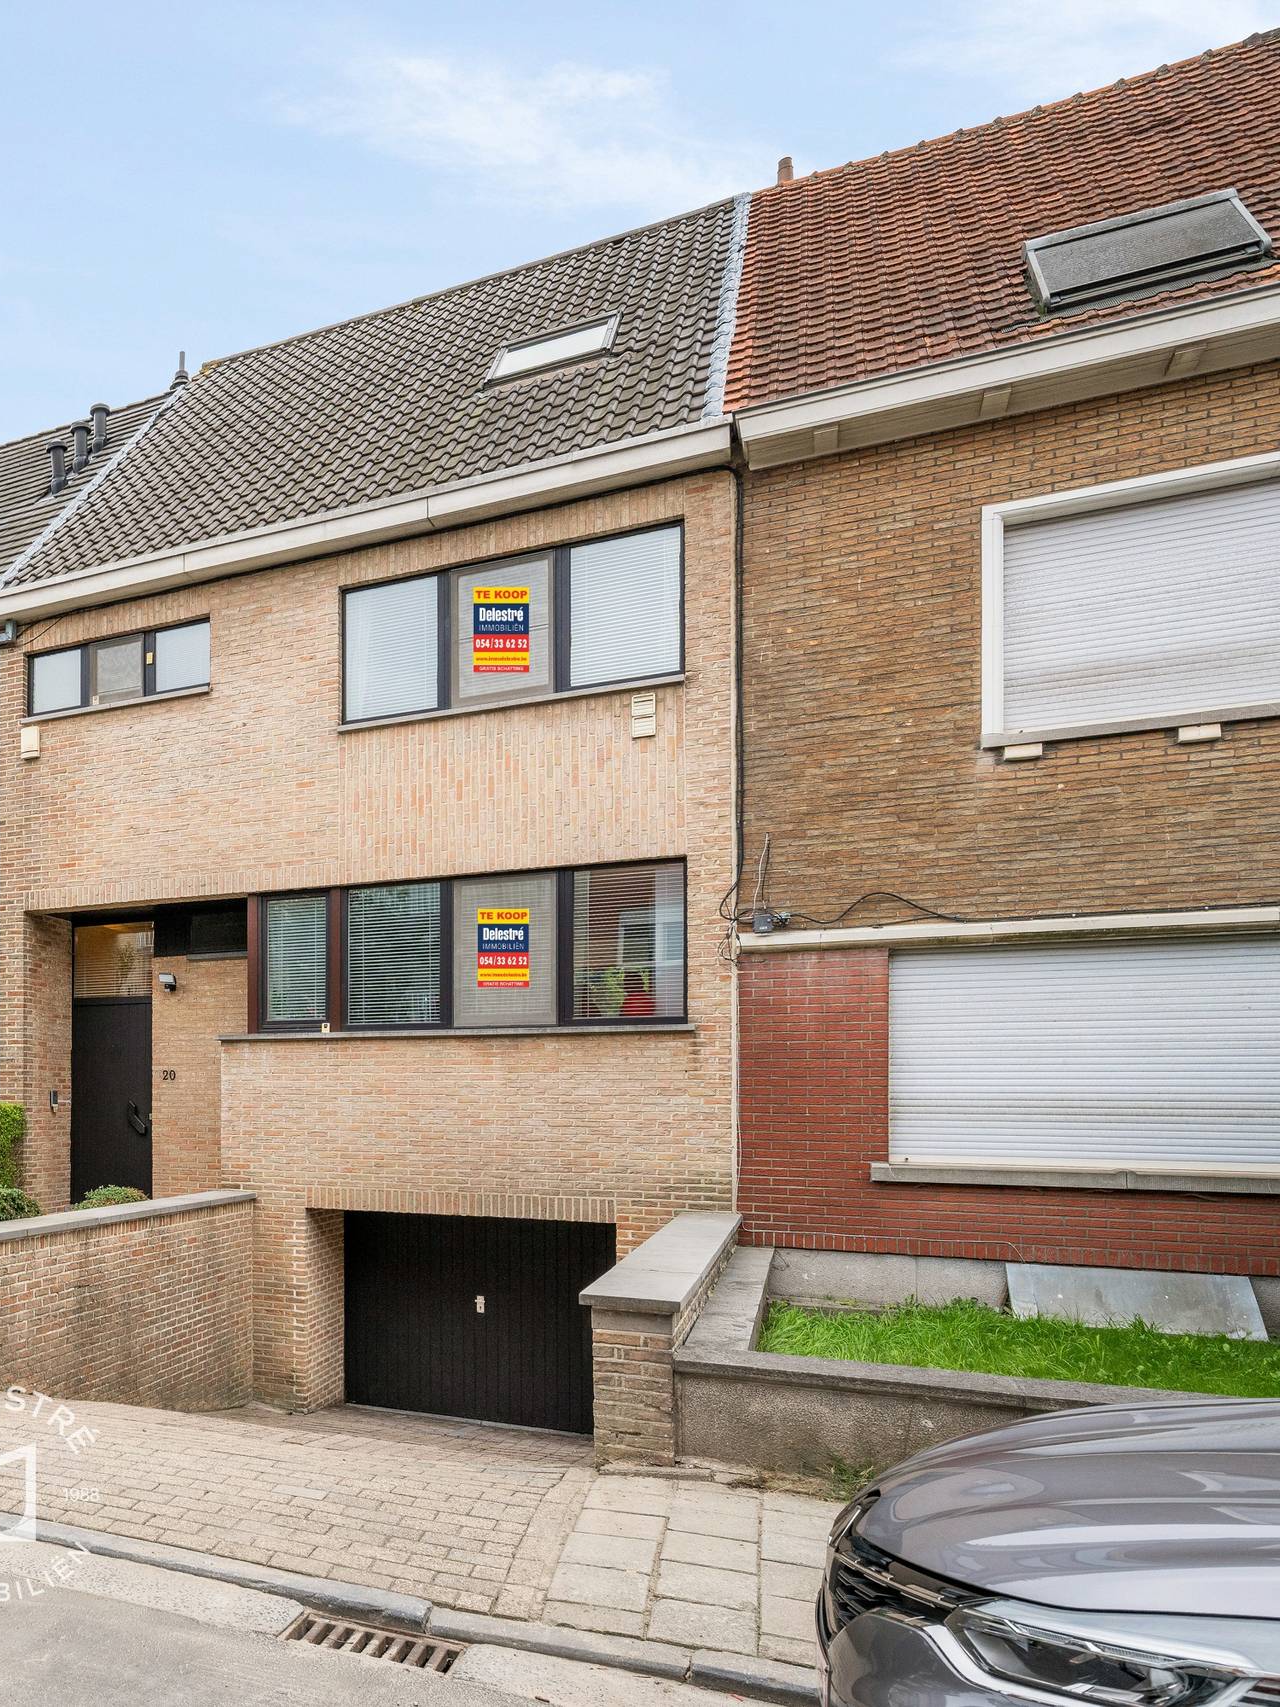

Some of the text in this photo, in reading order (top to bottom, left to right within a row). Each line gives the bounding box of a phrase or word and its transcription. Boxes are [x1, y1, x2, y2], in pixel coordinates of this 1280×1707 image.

[475, 590, 527, 599] TE KOOP
[479, 607, 524, 622] Delestré
[475, 639, 527, 648] 054/33 62 52
[479, 912, 527, 920] TE KOOP
[483, 927, 524, 940] Delestré
[479, 957, 527, 965] 054/33 62 52
[162, 1069, 176, 1081] 20
